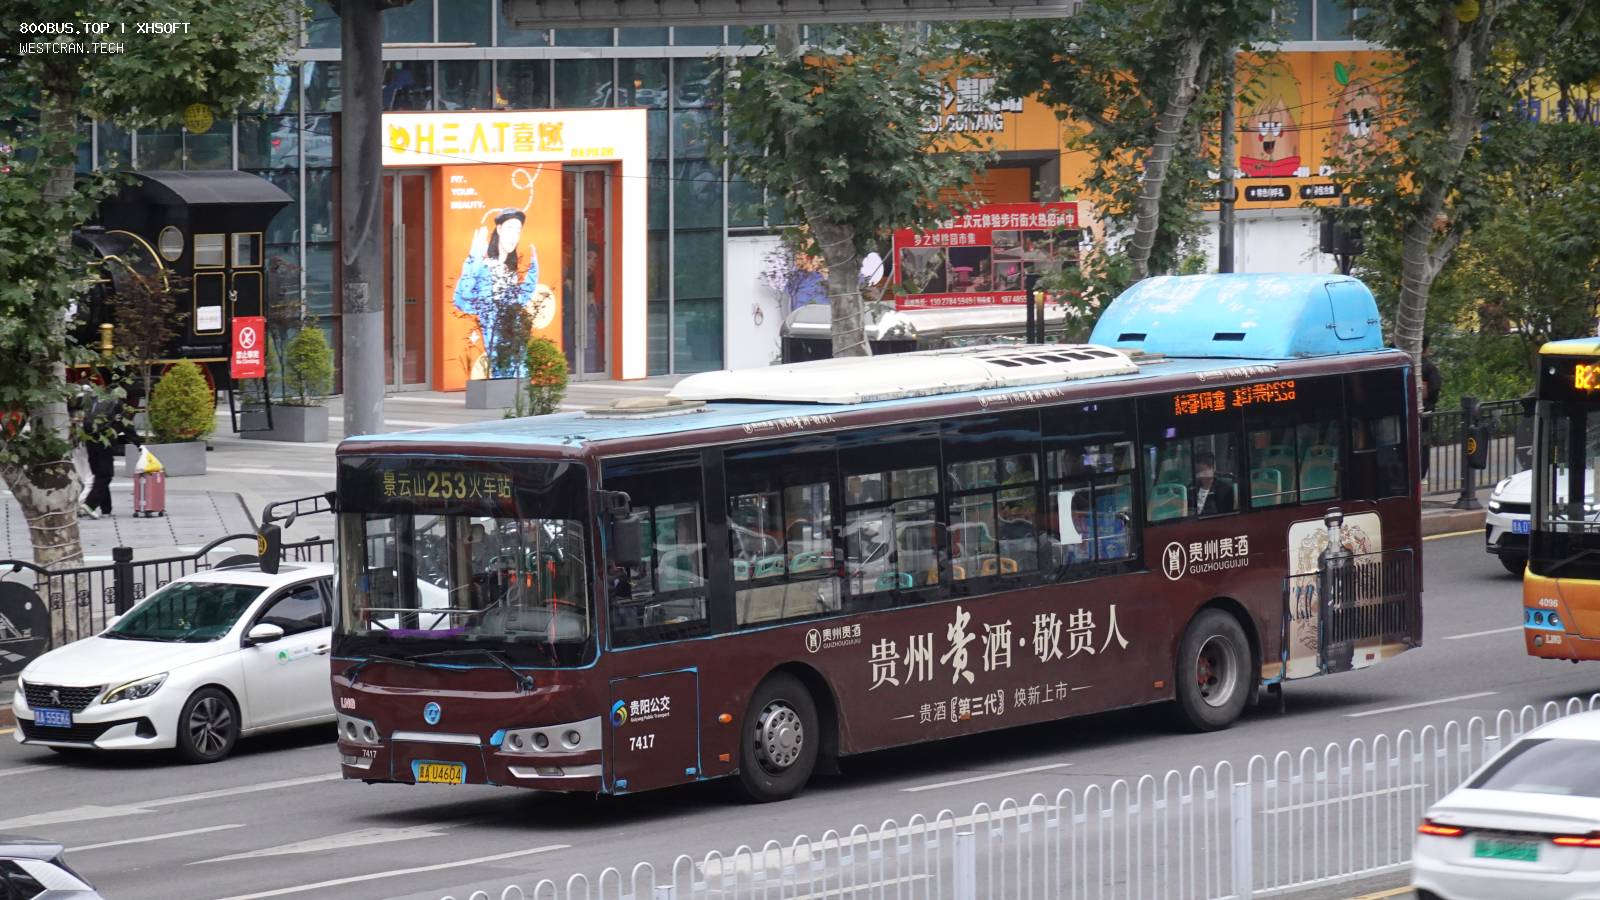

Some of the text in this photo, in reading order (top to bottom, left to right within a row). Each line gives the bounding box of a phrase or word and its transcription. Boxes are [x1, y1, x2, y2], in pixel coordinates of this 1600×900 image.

[1188, 534, 1249, 564] 贵州贵酒
[1189, 557, 1249, 575] GUIZHOUGUIJIU
[822, 623, 861, 642] 贵州贵酒
[630, 695, 670, 717] 贵阳公交
[629, 733, 655, 752] 7417
[362, 749, 378, 759] 7417
